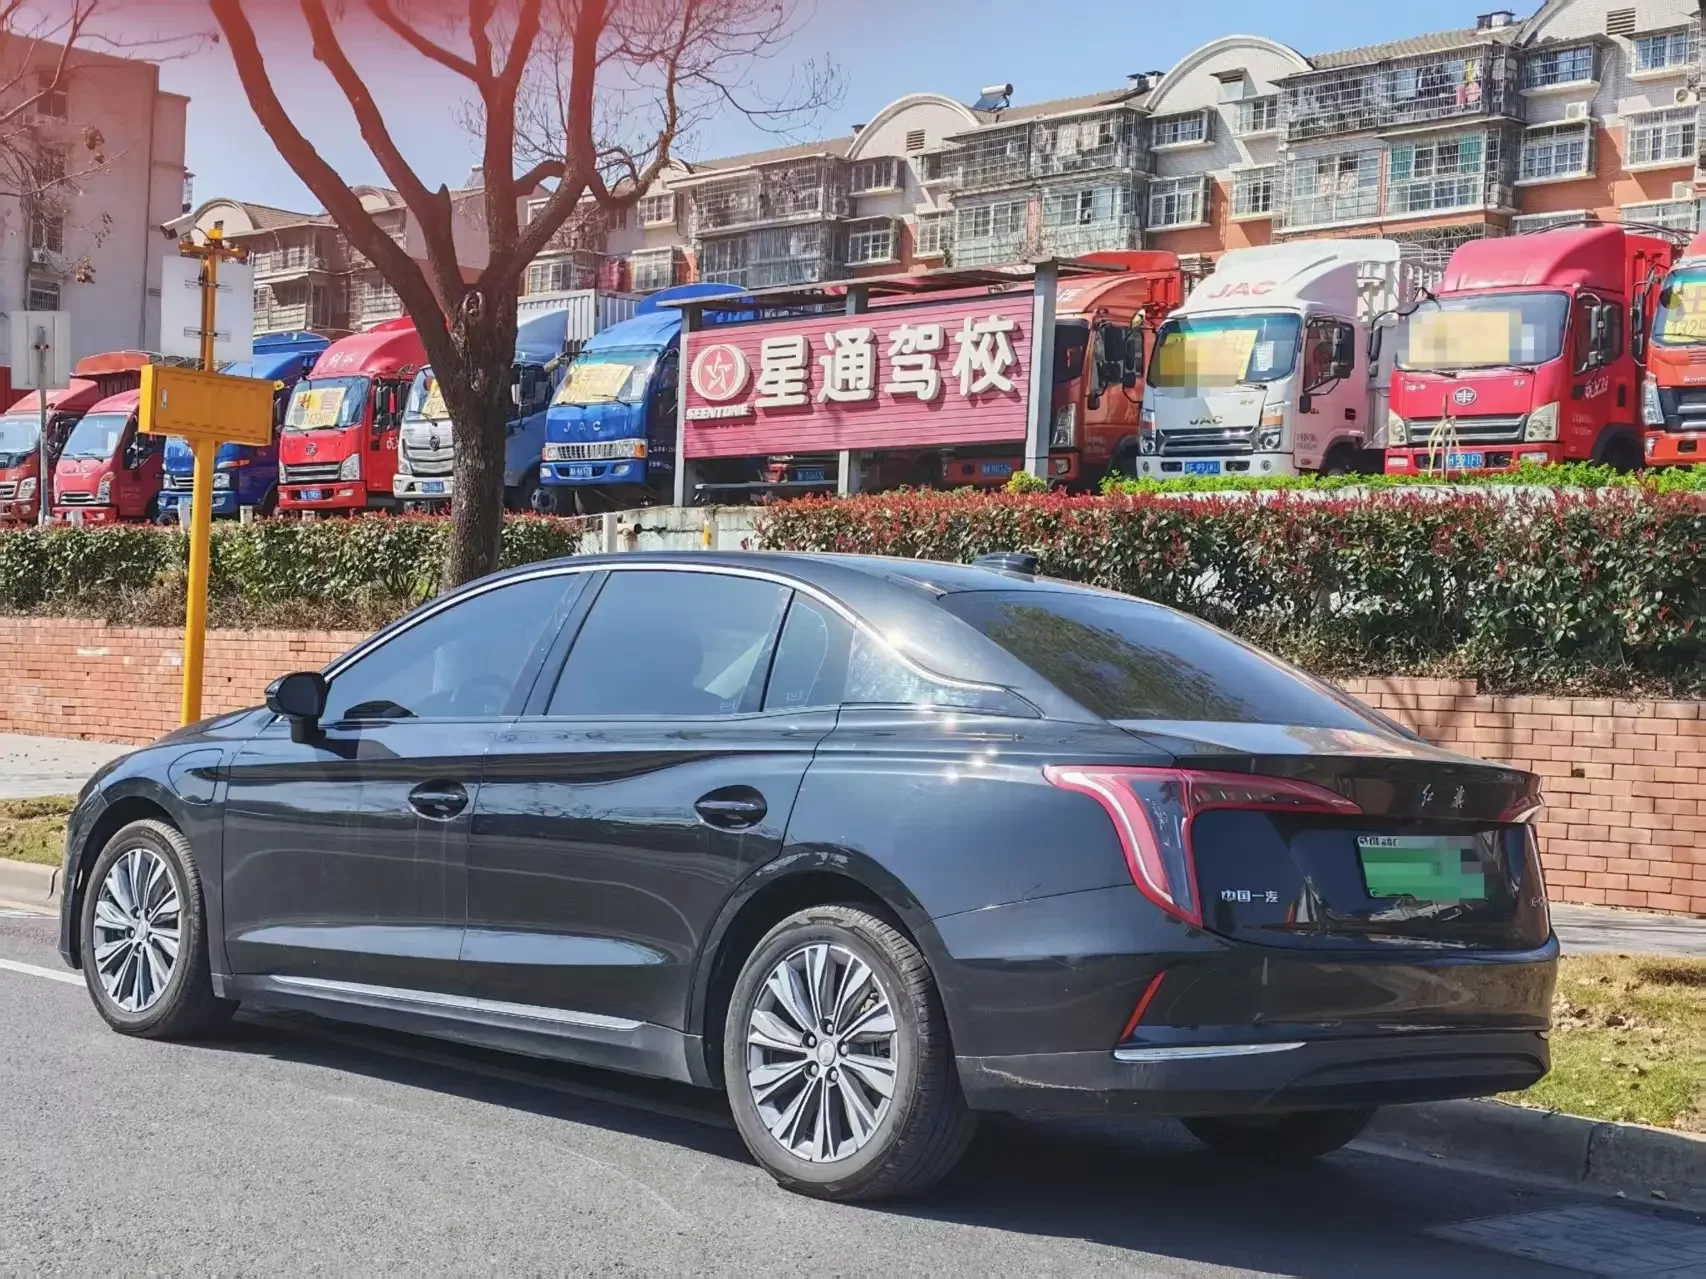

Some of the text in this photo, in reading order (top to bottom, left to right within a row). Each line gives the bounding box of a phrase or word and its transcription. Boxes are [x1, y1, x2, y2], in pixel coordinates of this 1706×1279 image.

[1208, 281, 1277, 298] JAC
[754, 314, 1019, 408] 星通驾校
[563, 420, 601, 433] JAC
[1189, 415, 1223, 426] JAC
[1221, 889, 1279, 903] 中国一汽
